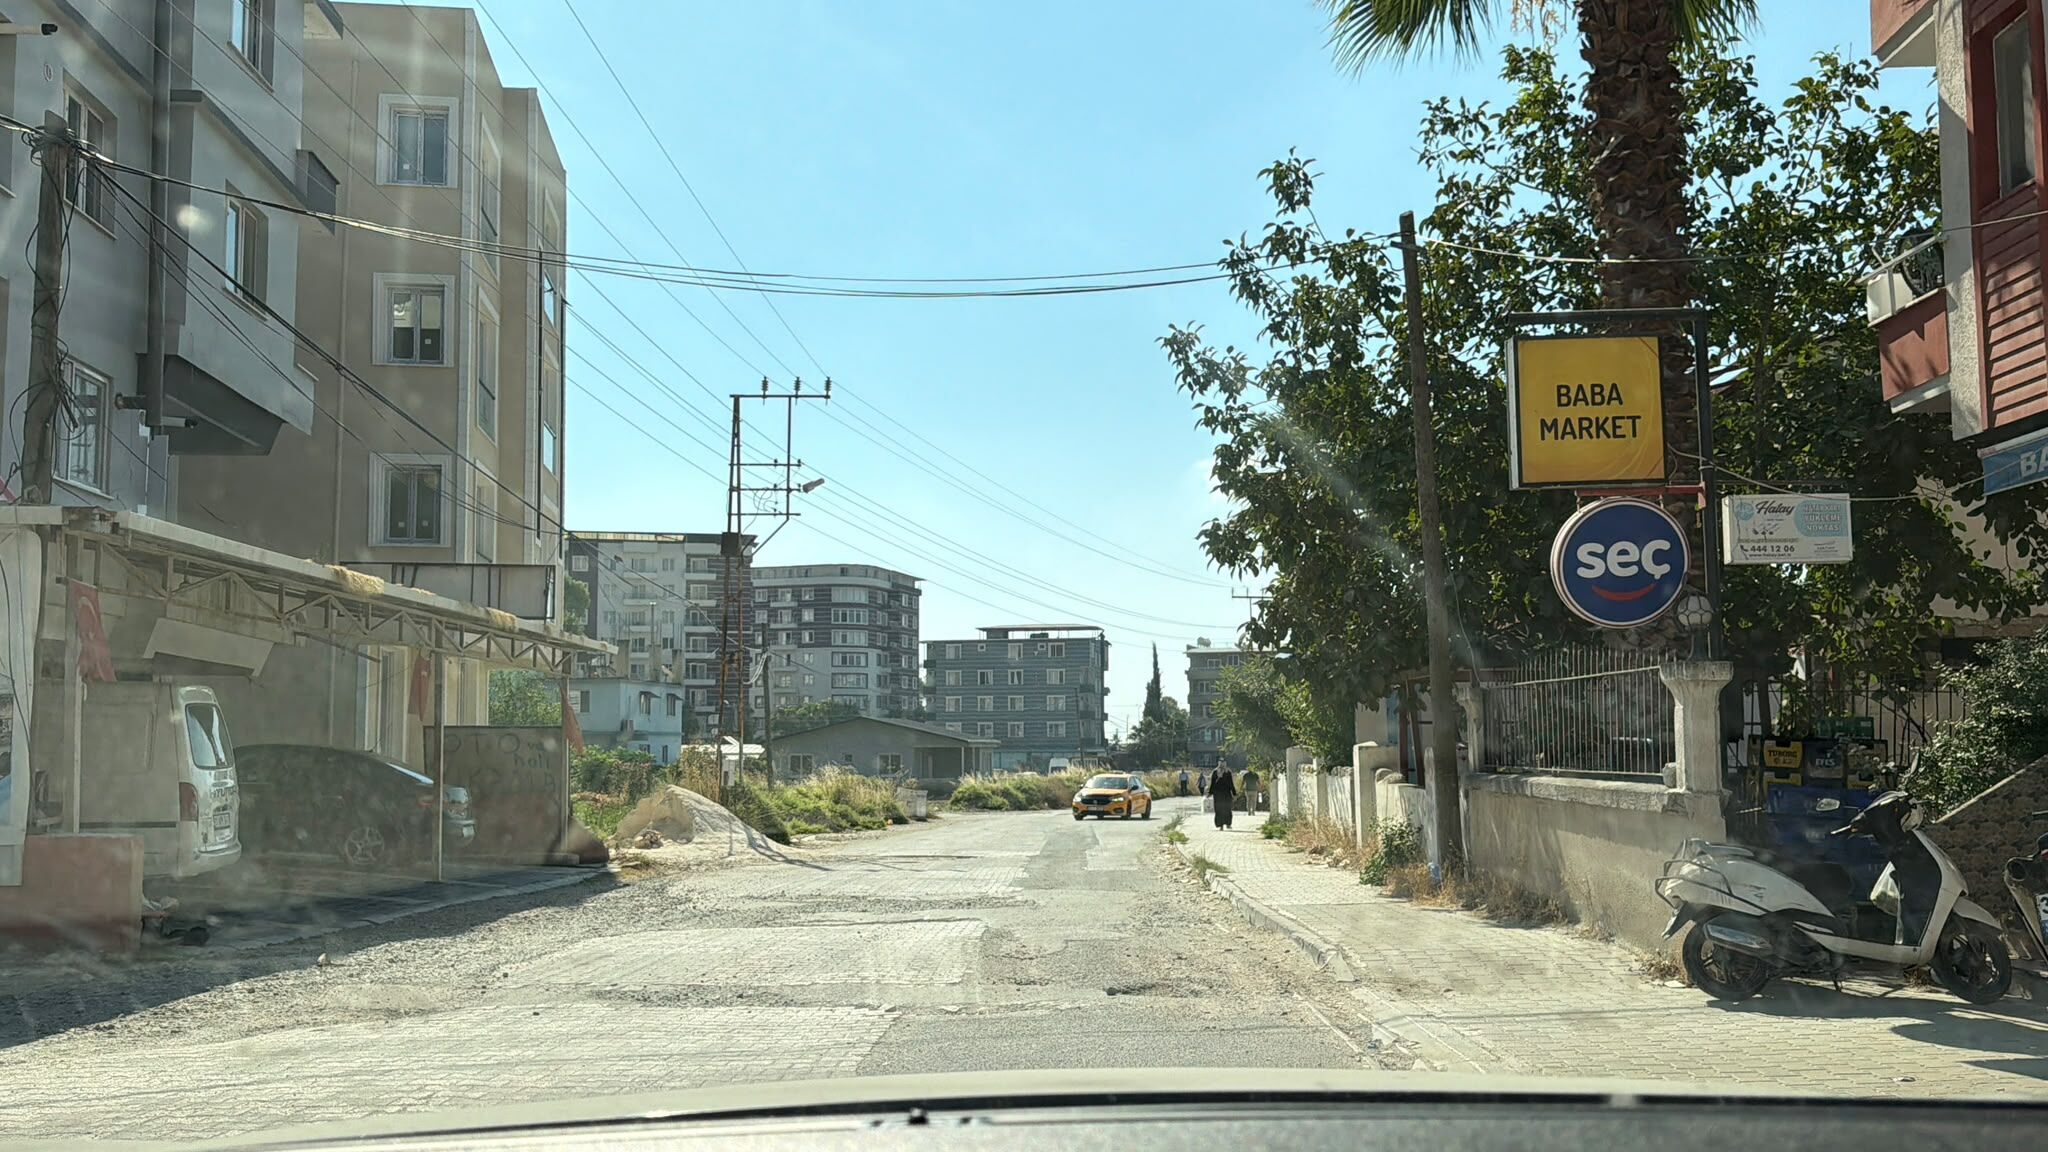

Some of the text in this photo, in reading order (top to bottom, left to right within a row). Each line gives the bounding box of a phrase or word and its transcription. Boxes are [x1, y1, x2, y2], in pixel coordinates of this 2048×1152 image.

[1556, 383, 1624, 408] BABA
[1540, 415, 1642, 441] MARKET
[1756, 500, 1796, 515] Hatay
[1576, 539, 1672, 580] seç
[1783, 544, 1795, 552] 06
